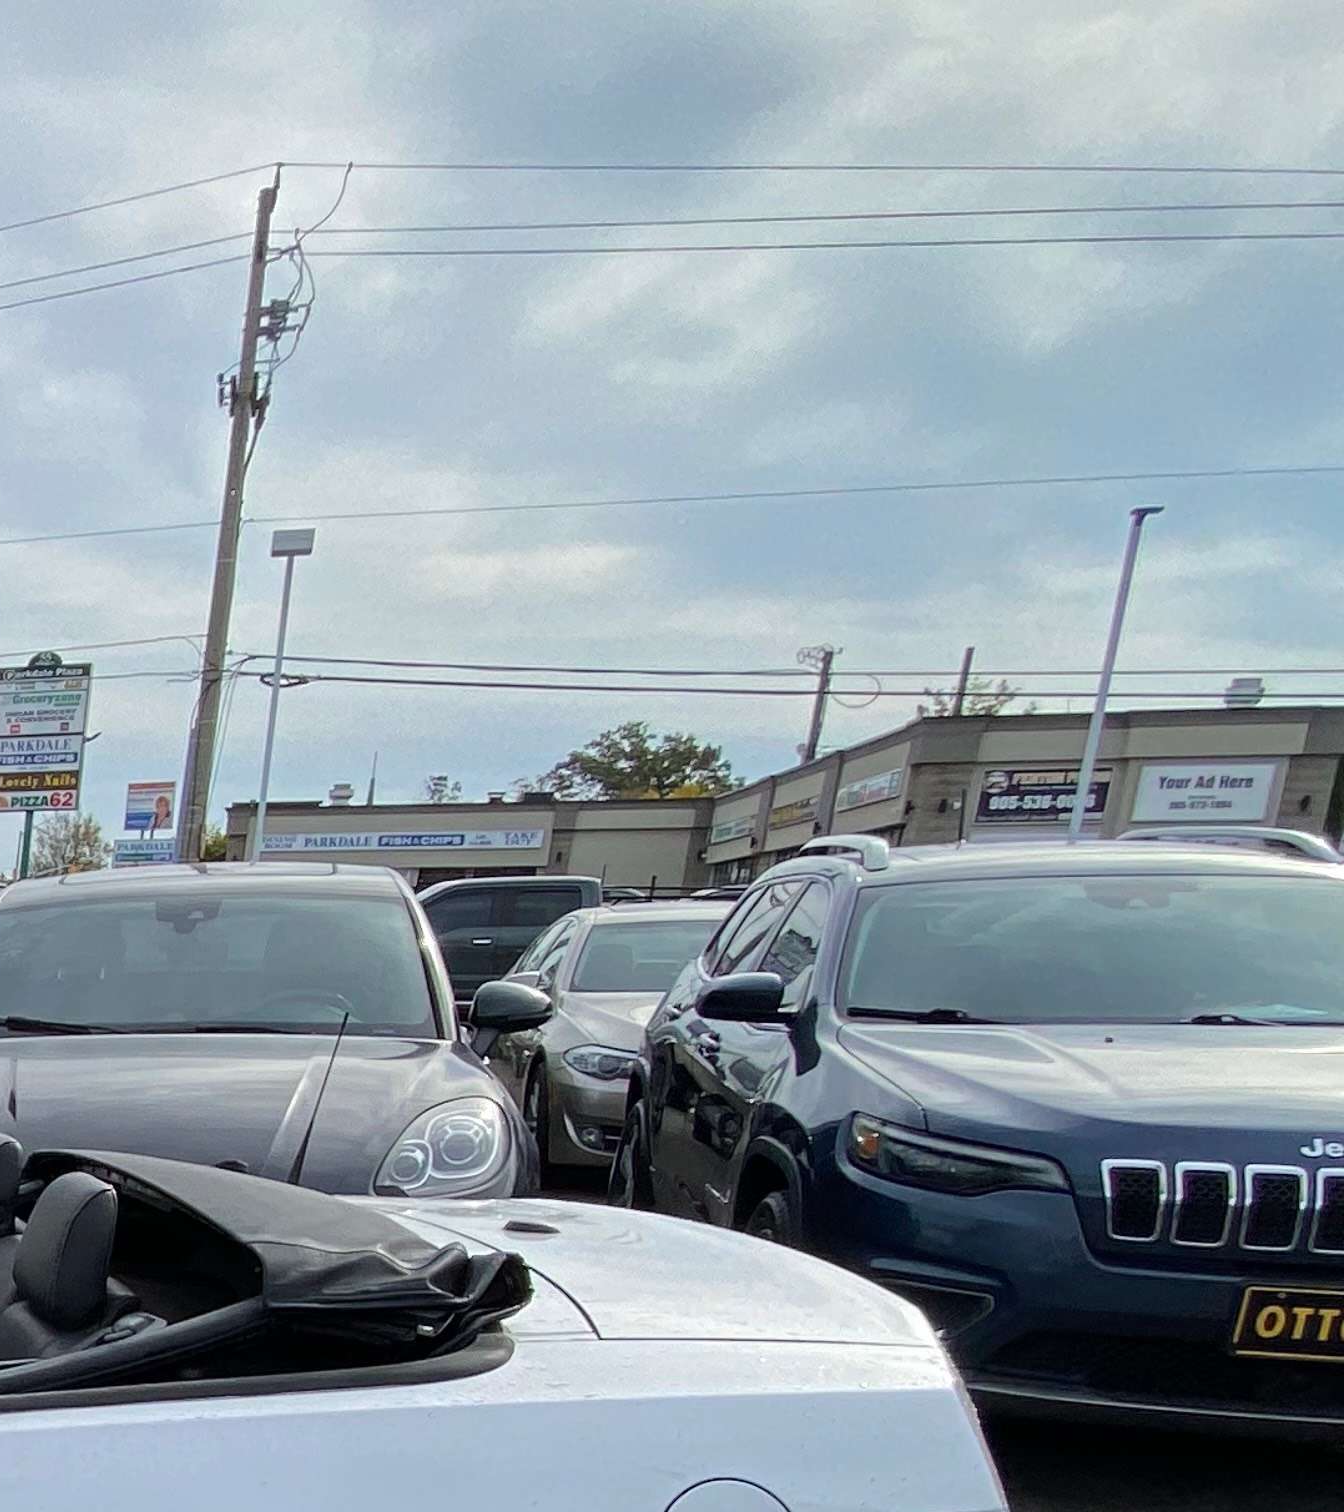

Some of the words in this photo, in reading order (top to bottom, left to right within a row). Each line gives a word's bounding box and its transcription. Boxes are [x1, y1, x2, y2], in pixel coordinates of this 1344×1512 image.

[0, 738, 72, 752] PARKDALE
[1159, 776, 1192, 789] Your
[1194, 776, 1216, 789] Ad
[1218, 775, 1254, 788] Here
[11, 796, 49, 807] PIZZA
[50, 792, 73, 806] 62
[304, 835, 373, 848] PARKDALE
[1254, 1305, 1344, 1342] OTT
